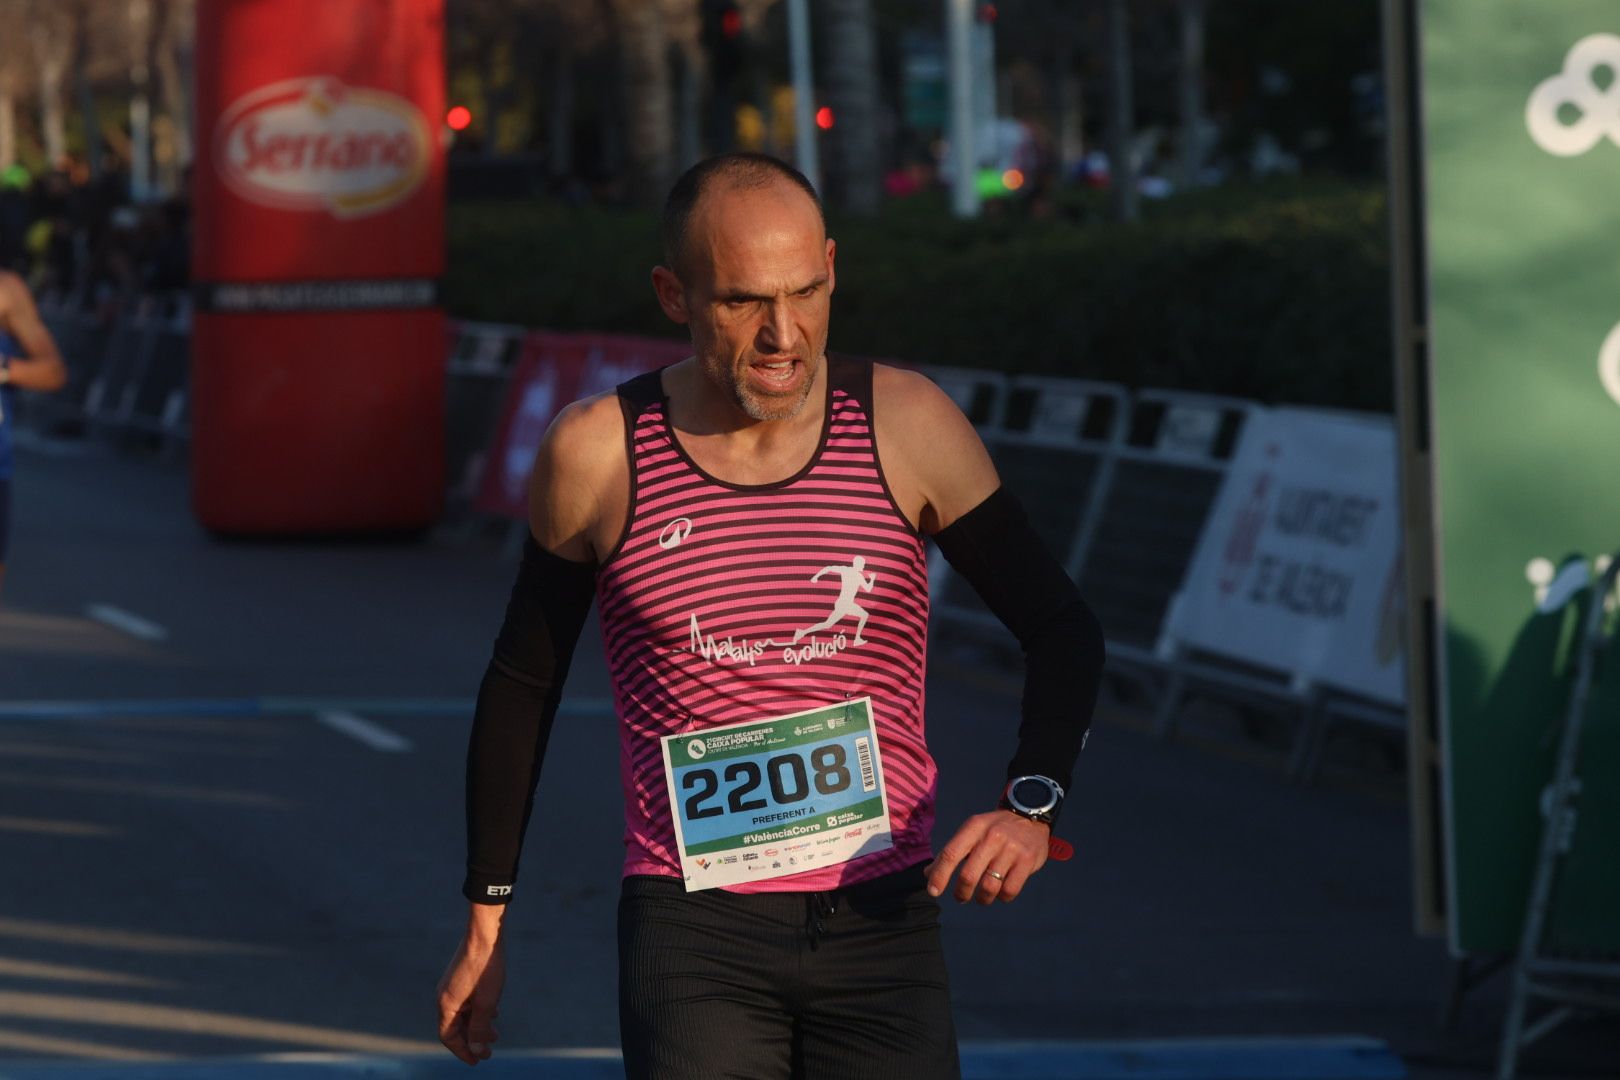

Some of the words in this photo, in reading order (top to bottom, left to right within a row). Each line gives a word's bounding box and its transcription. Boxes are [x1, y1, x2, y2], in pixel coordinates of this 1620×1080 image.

[243, 118, 413, 174] Serrano
[783, 629, 847, 666] evolució
[706, 740, 731, 750] CAIXA
[731, 734, 765, 745] POPULAR
[682, 744, 851, 820] 2208
[752, 808, 806, 825] PREFERENT
[743, 823, 821, 845] #ValènciaCorre
